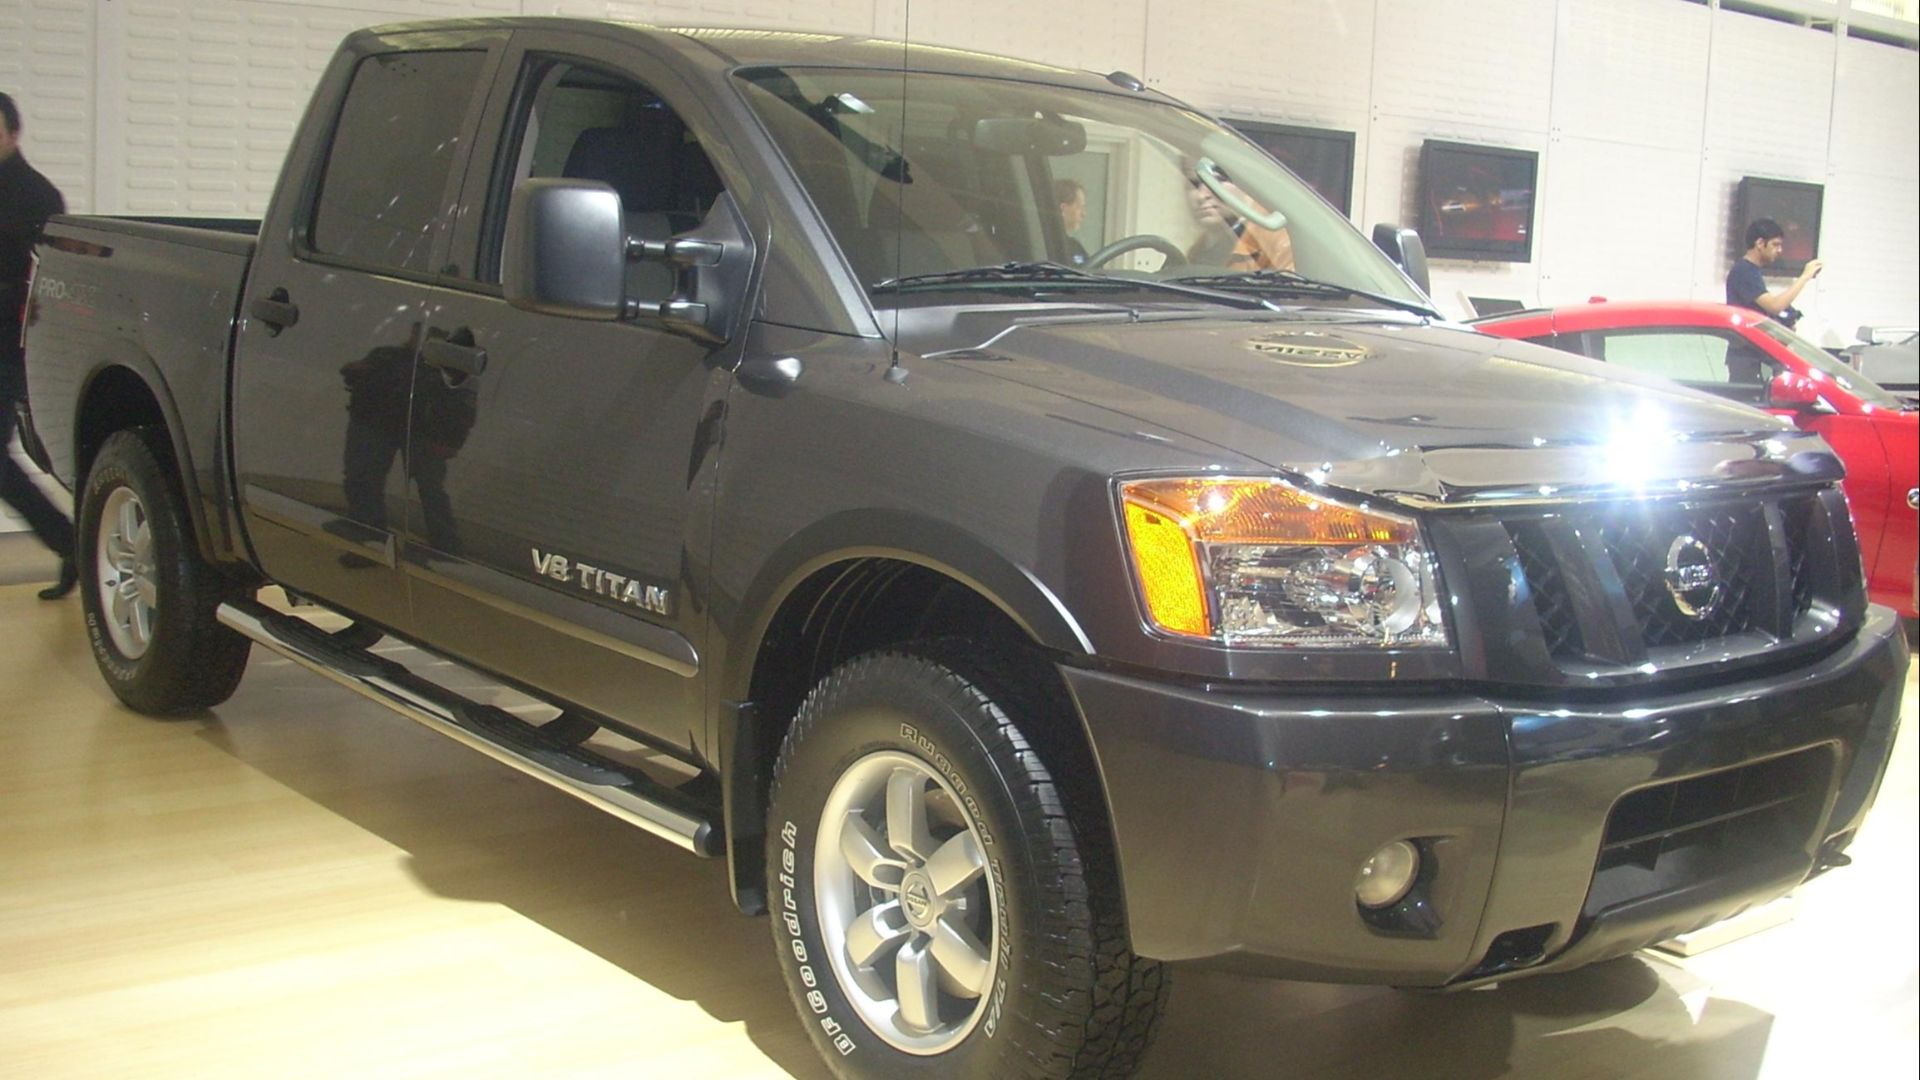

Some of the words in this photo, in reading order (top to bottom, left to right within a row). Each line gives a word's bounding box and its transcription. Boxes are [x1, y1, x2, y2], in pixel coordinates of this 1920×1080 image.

[531, 548, 571, 582] V8
[576, 562, 669, 616] TITAN
[779, 820, 856, 1056] BFGoodrich
[900, 723, 993, 846] Rugged
[983, 978, 1007, 1039] T/A
